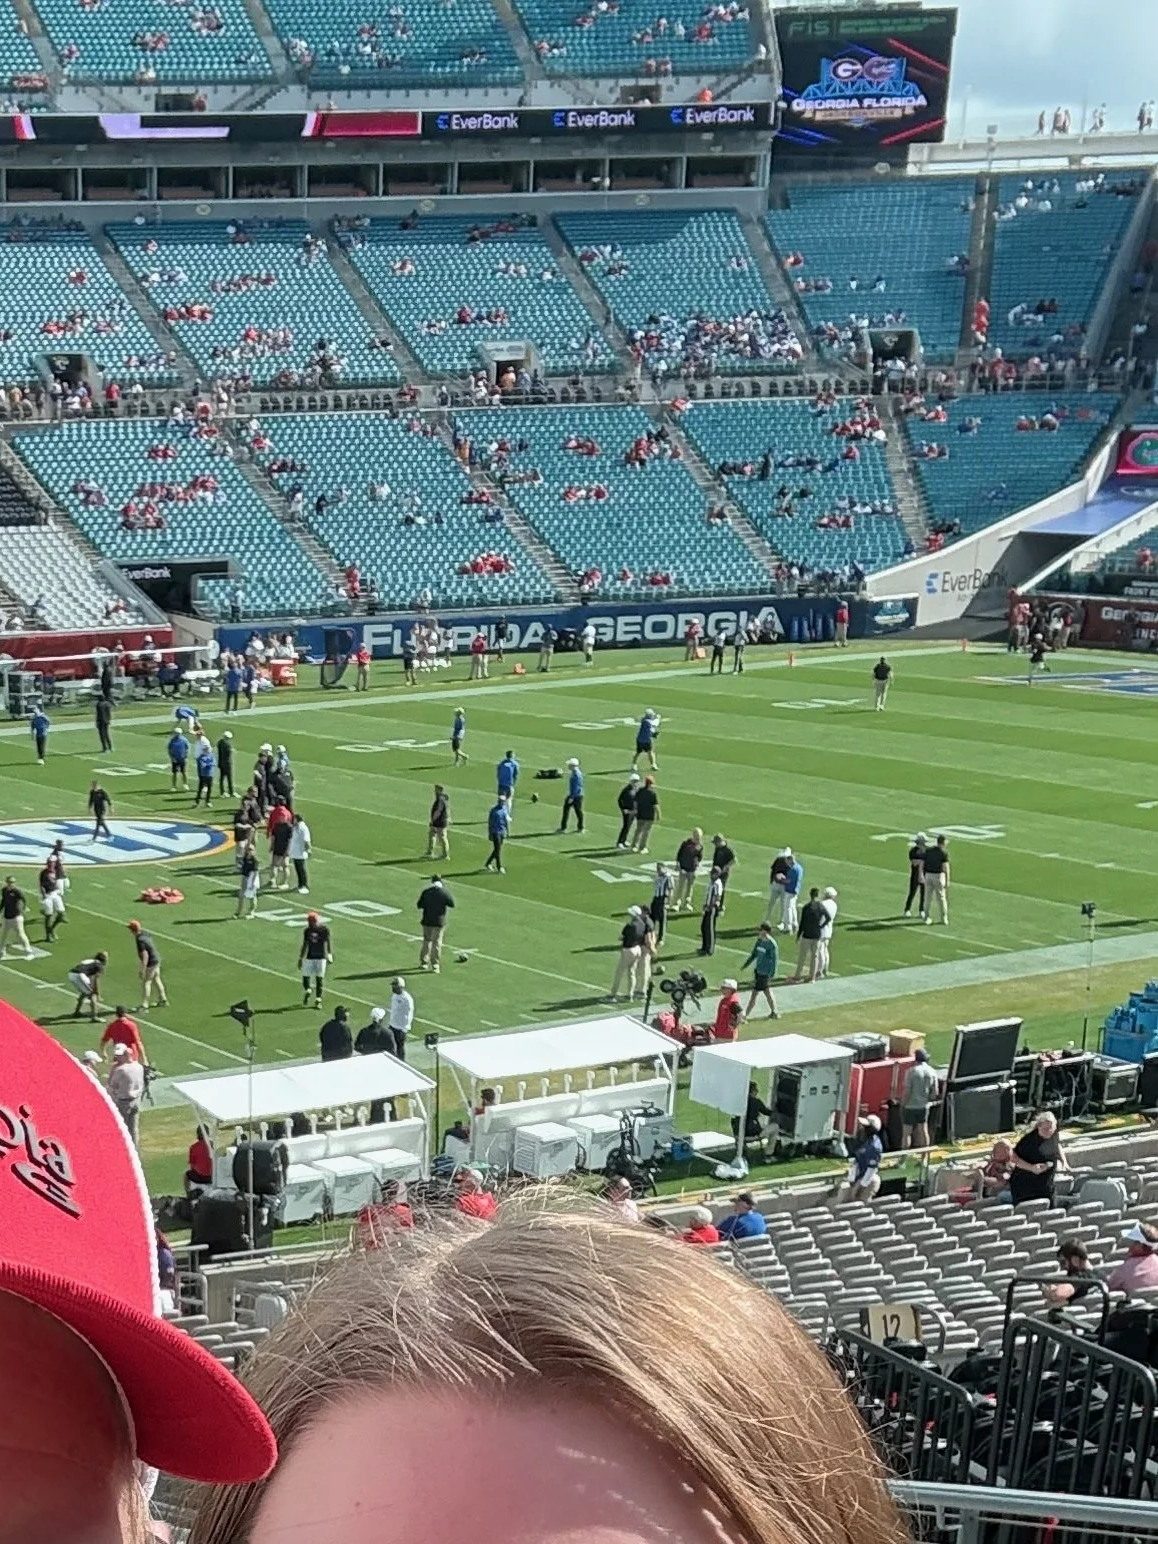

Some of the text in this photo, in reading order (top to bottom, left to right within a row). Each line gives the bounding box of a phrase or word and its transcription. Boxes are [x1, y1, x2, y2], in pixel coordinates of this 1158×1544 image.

[792, 94, 927, 111] GEORGIA FLORIDA
[451, 113, 519, 130] EverBank
[567, 109, 635, 128] EverBank
[685, 106, 755, 124] EverBank
[122, 566, 172, 579] EverBank
[940, 565, 1007, 592] EverBank
[363, 606, 785, 656] FLRIDA GEORGIA
